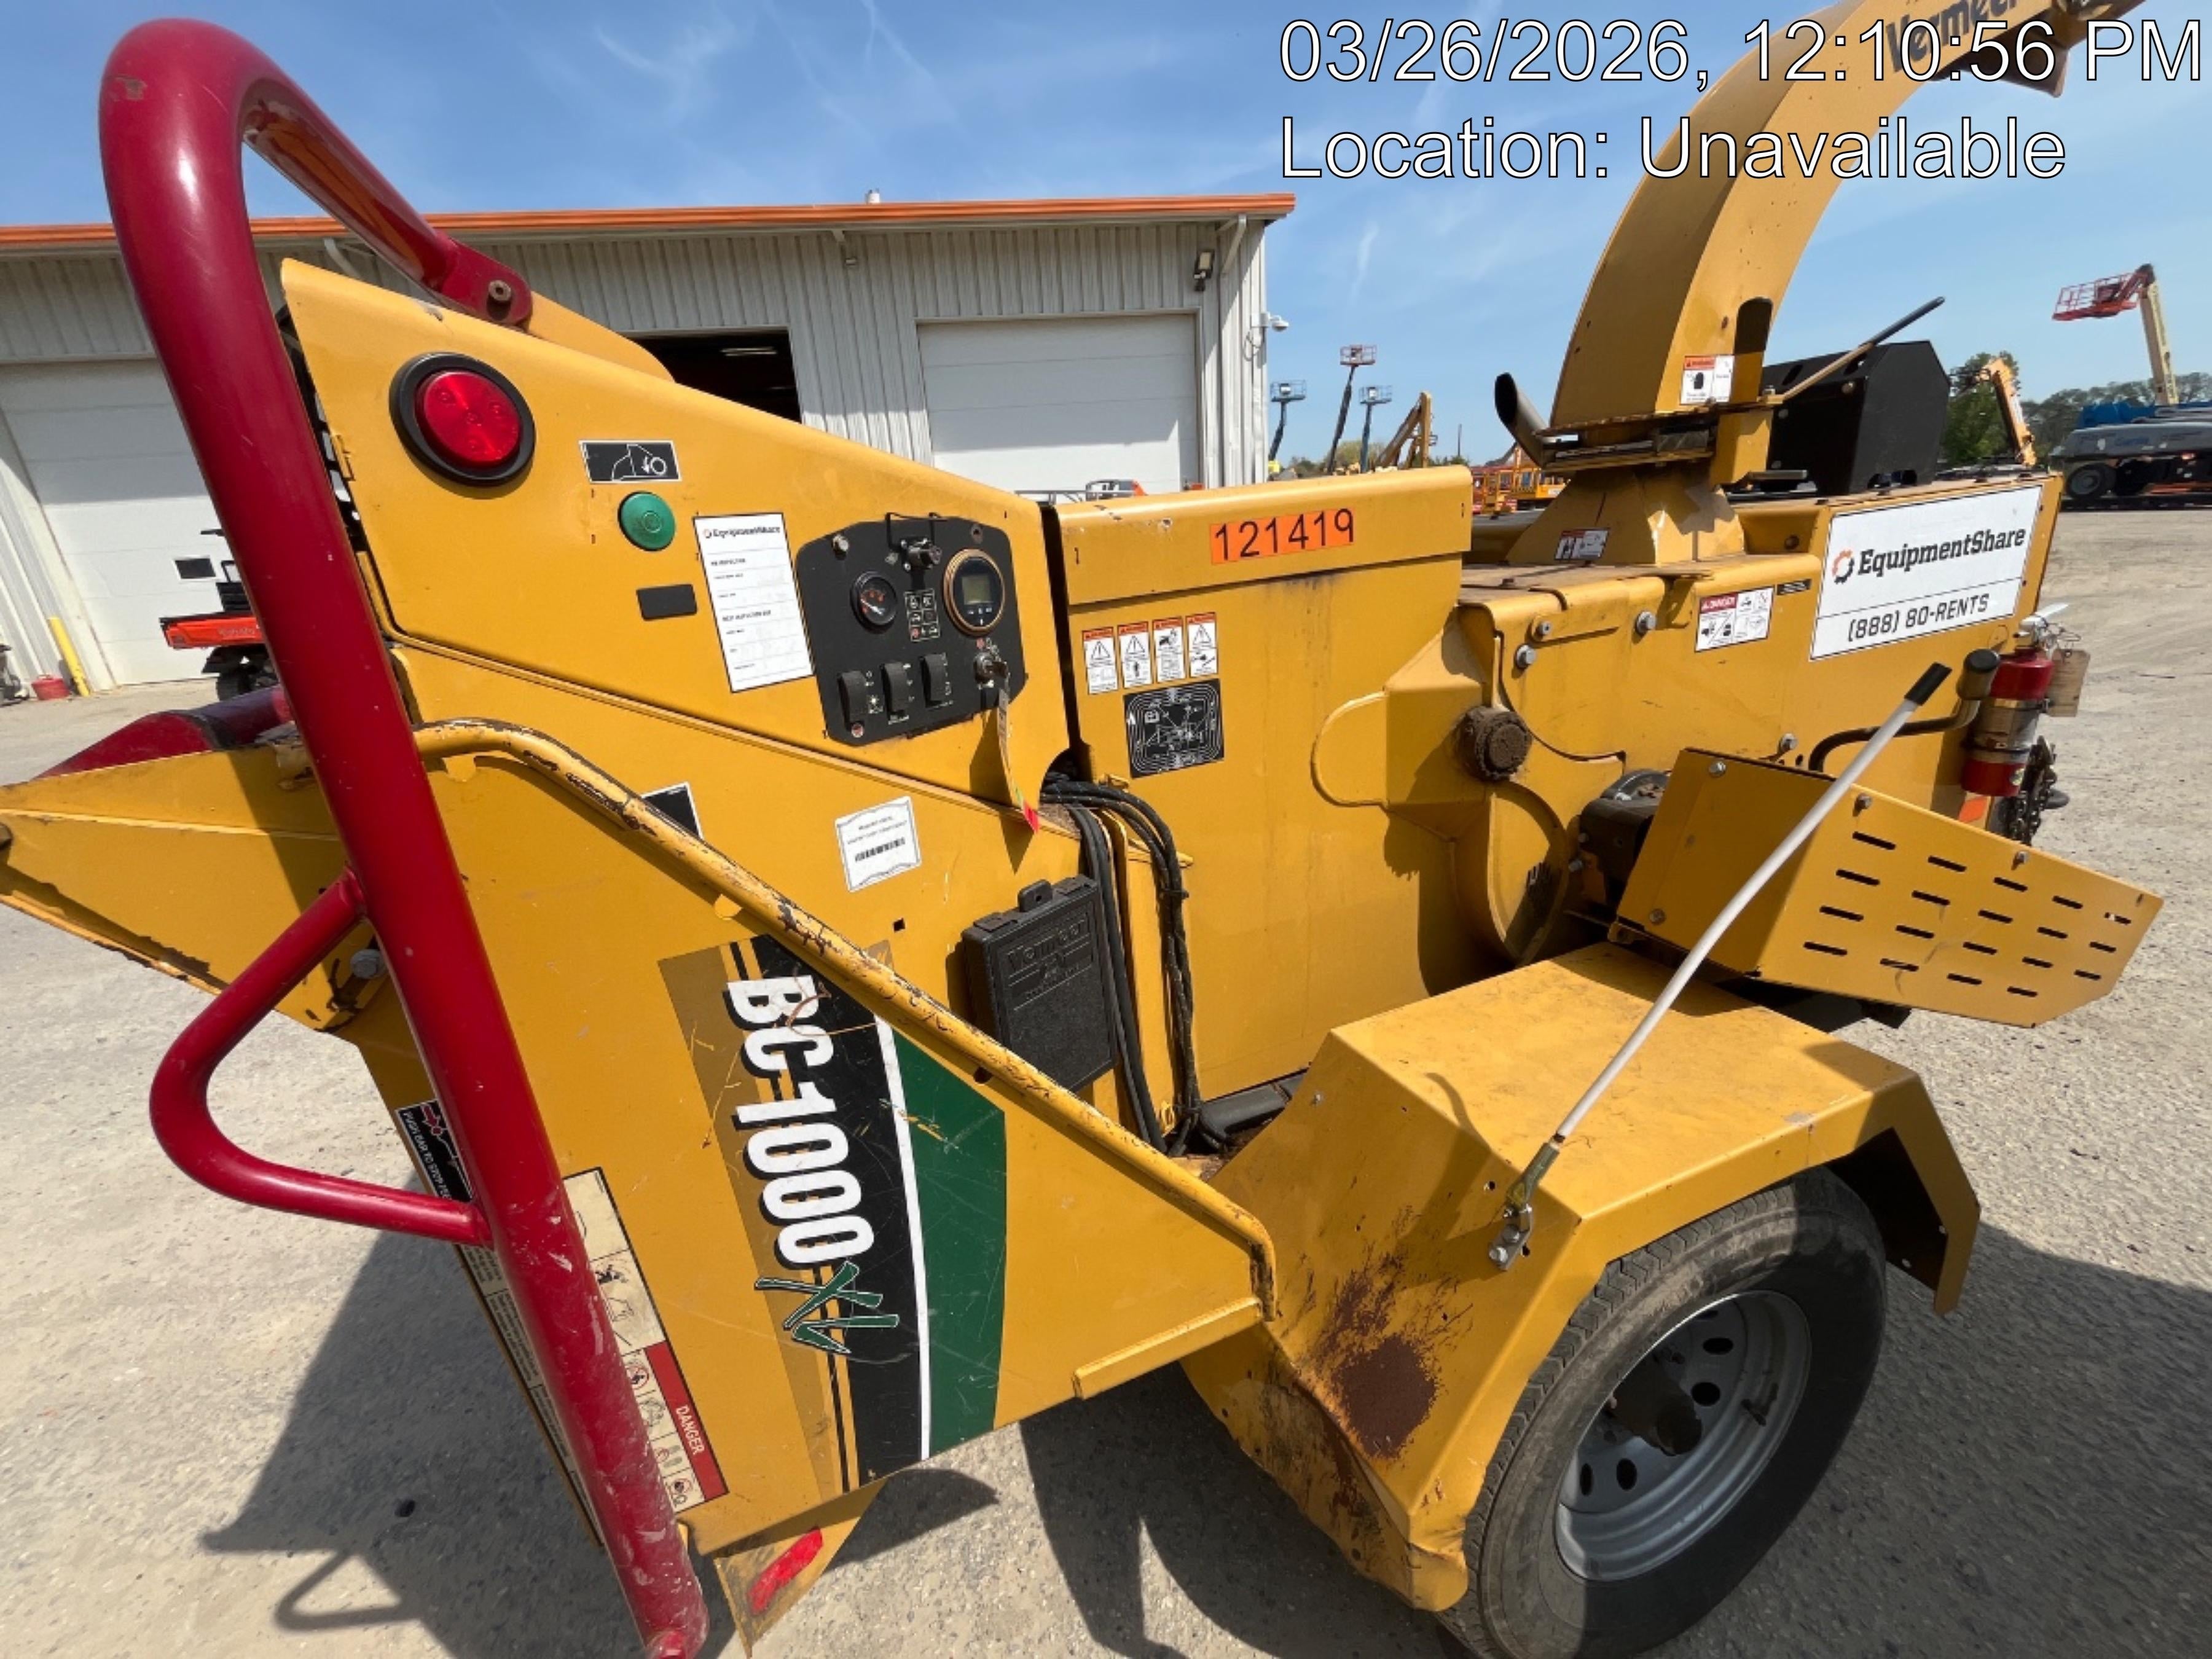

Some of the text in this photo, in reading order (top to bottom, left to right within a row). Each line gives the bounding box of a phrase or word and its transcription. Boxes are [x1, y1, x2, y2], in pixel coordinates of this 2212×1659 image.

[1886, 0, 2018, 73] Verme
[1214, 508, 1354, 561] 121419
[1857, 528, 2026, 577] EquipmentShare
[1848, 593, 1990, 642] (888) 80-RENTS
[402, 1111, 421, 1134] PUSH
[734, 1081, 875, 1266] 1000
[676, 1404, 705, 1456] DANGER
